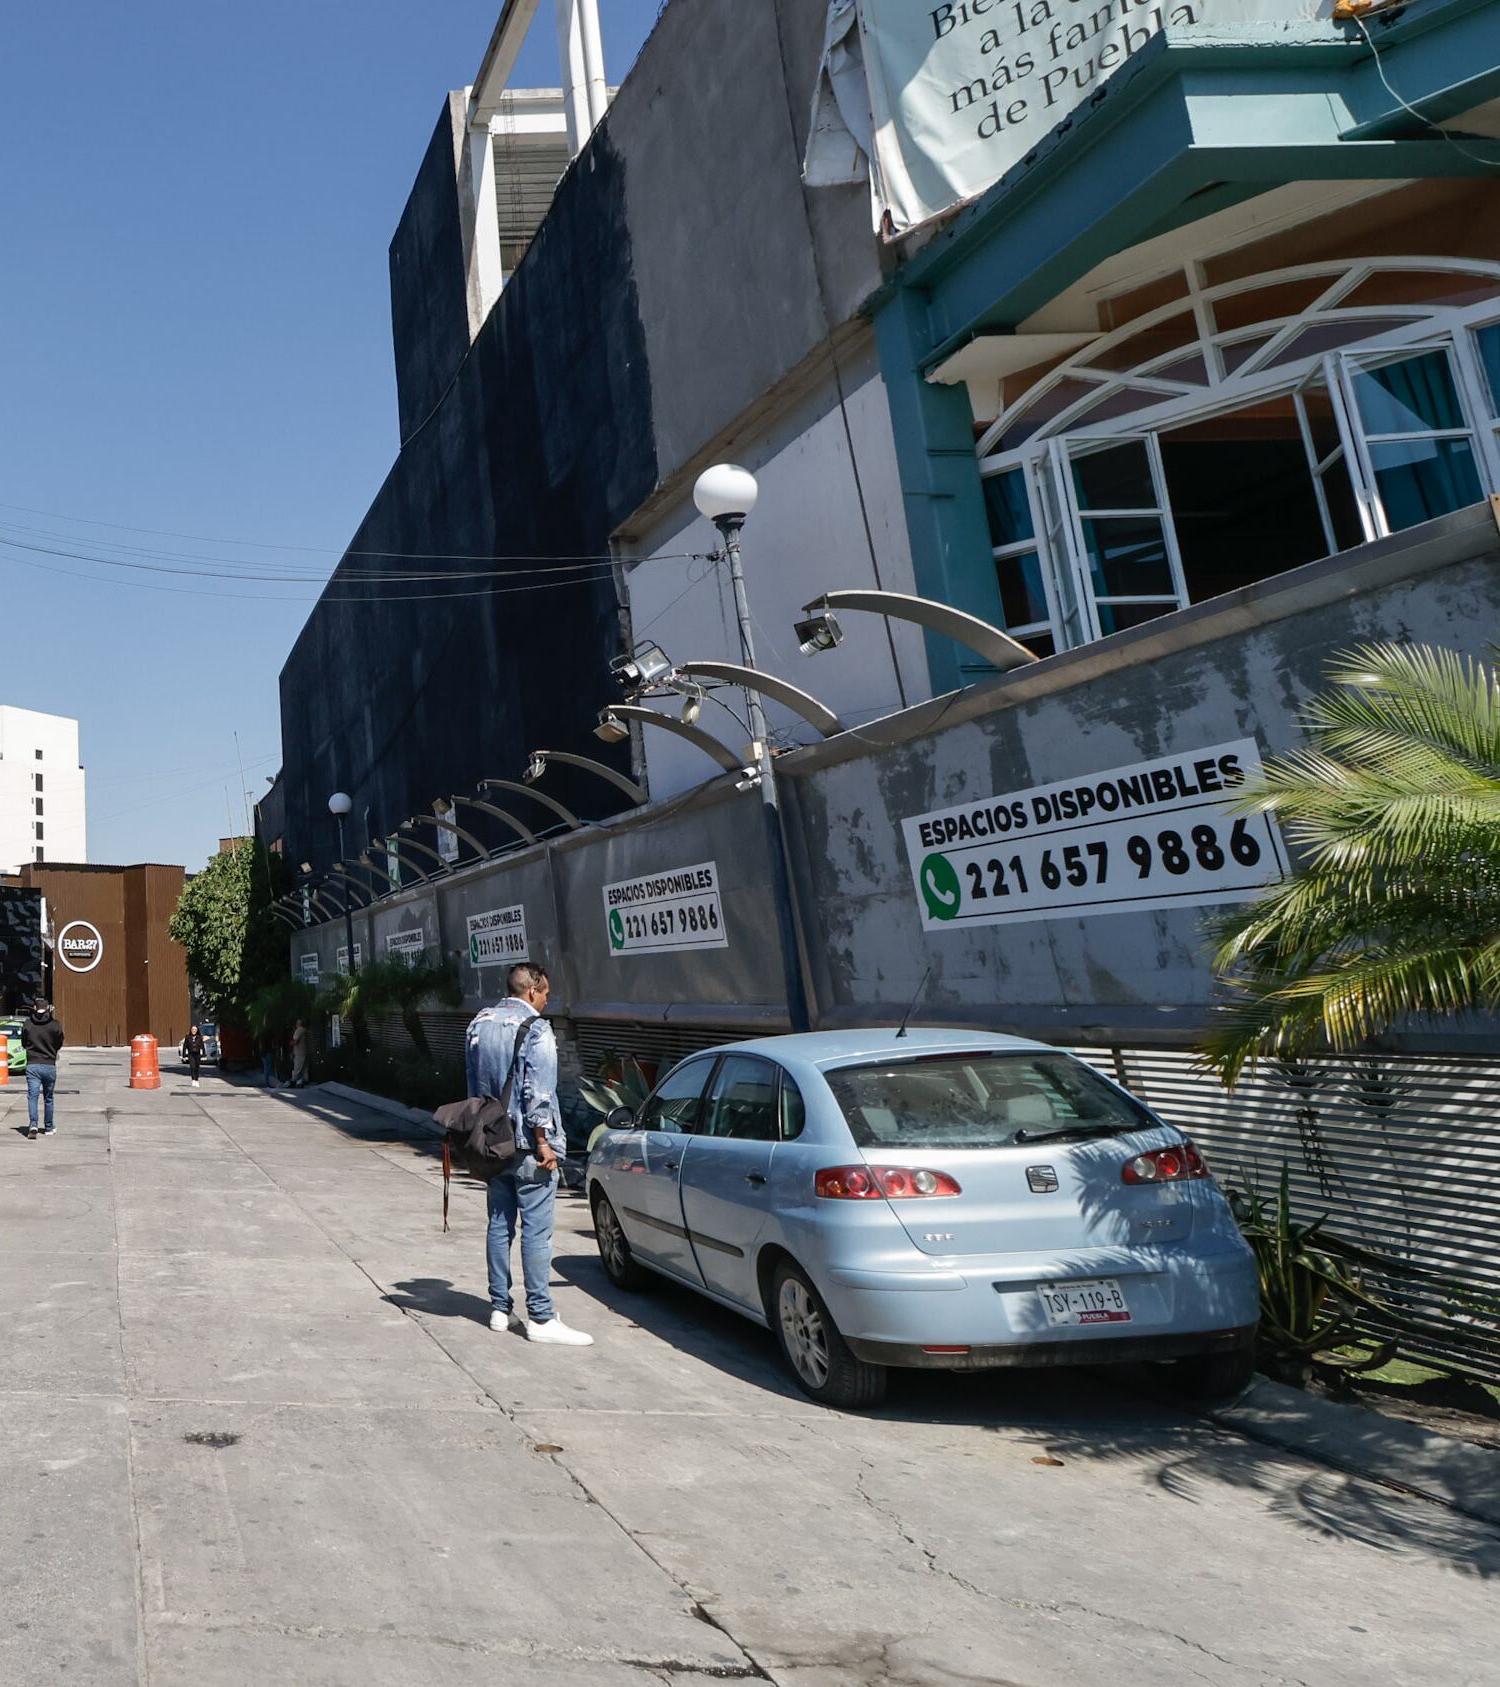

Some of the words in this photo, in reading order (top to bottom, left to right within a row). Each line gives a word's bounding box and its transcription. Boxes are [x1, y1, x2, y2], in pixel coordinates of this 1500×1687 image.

[928, 0, 1005, 41] Bie
[980, 28, 1004, 55] a
[1012, 0, 1055, 36] la
[948, 52, 1035, 114] más
[1048, 0, 1151, 61] fam
[977, 99, 1029, 139] de
[1038, 2, 1199, 109] Puebla
[918, 801, 1029, 848] ESPACIOS
[1033, 754, 1246, 825] DISPONIBLES
[965, 855, 1029, 900] 221
[1040, 841, 1109, 890] 657
[1127, 818, 1261, 880] 9886
[608, 883, 646, 905] ESPACIOS
[645, 869, 713, 898] DISPONIBLES
[625, 914, 648, 939] 221
[651, 910, 674, 936] 657
[678, 904, 718, 933] 9886
[1043, 1289, 1123, 1313] TSY-119-B
